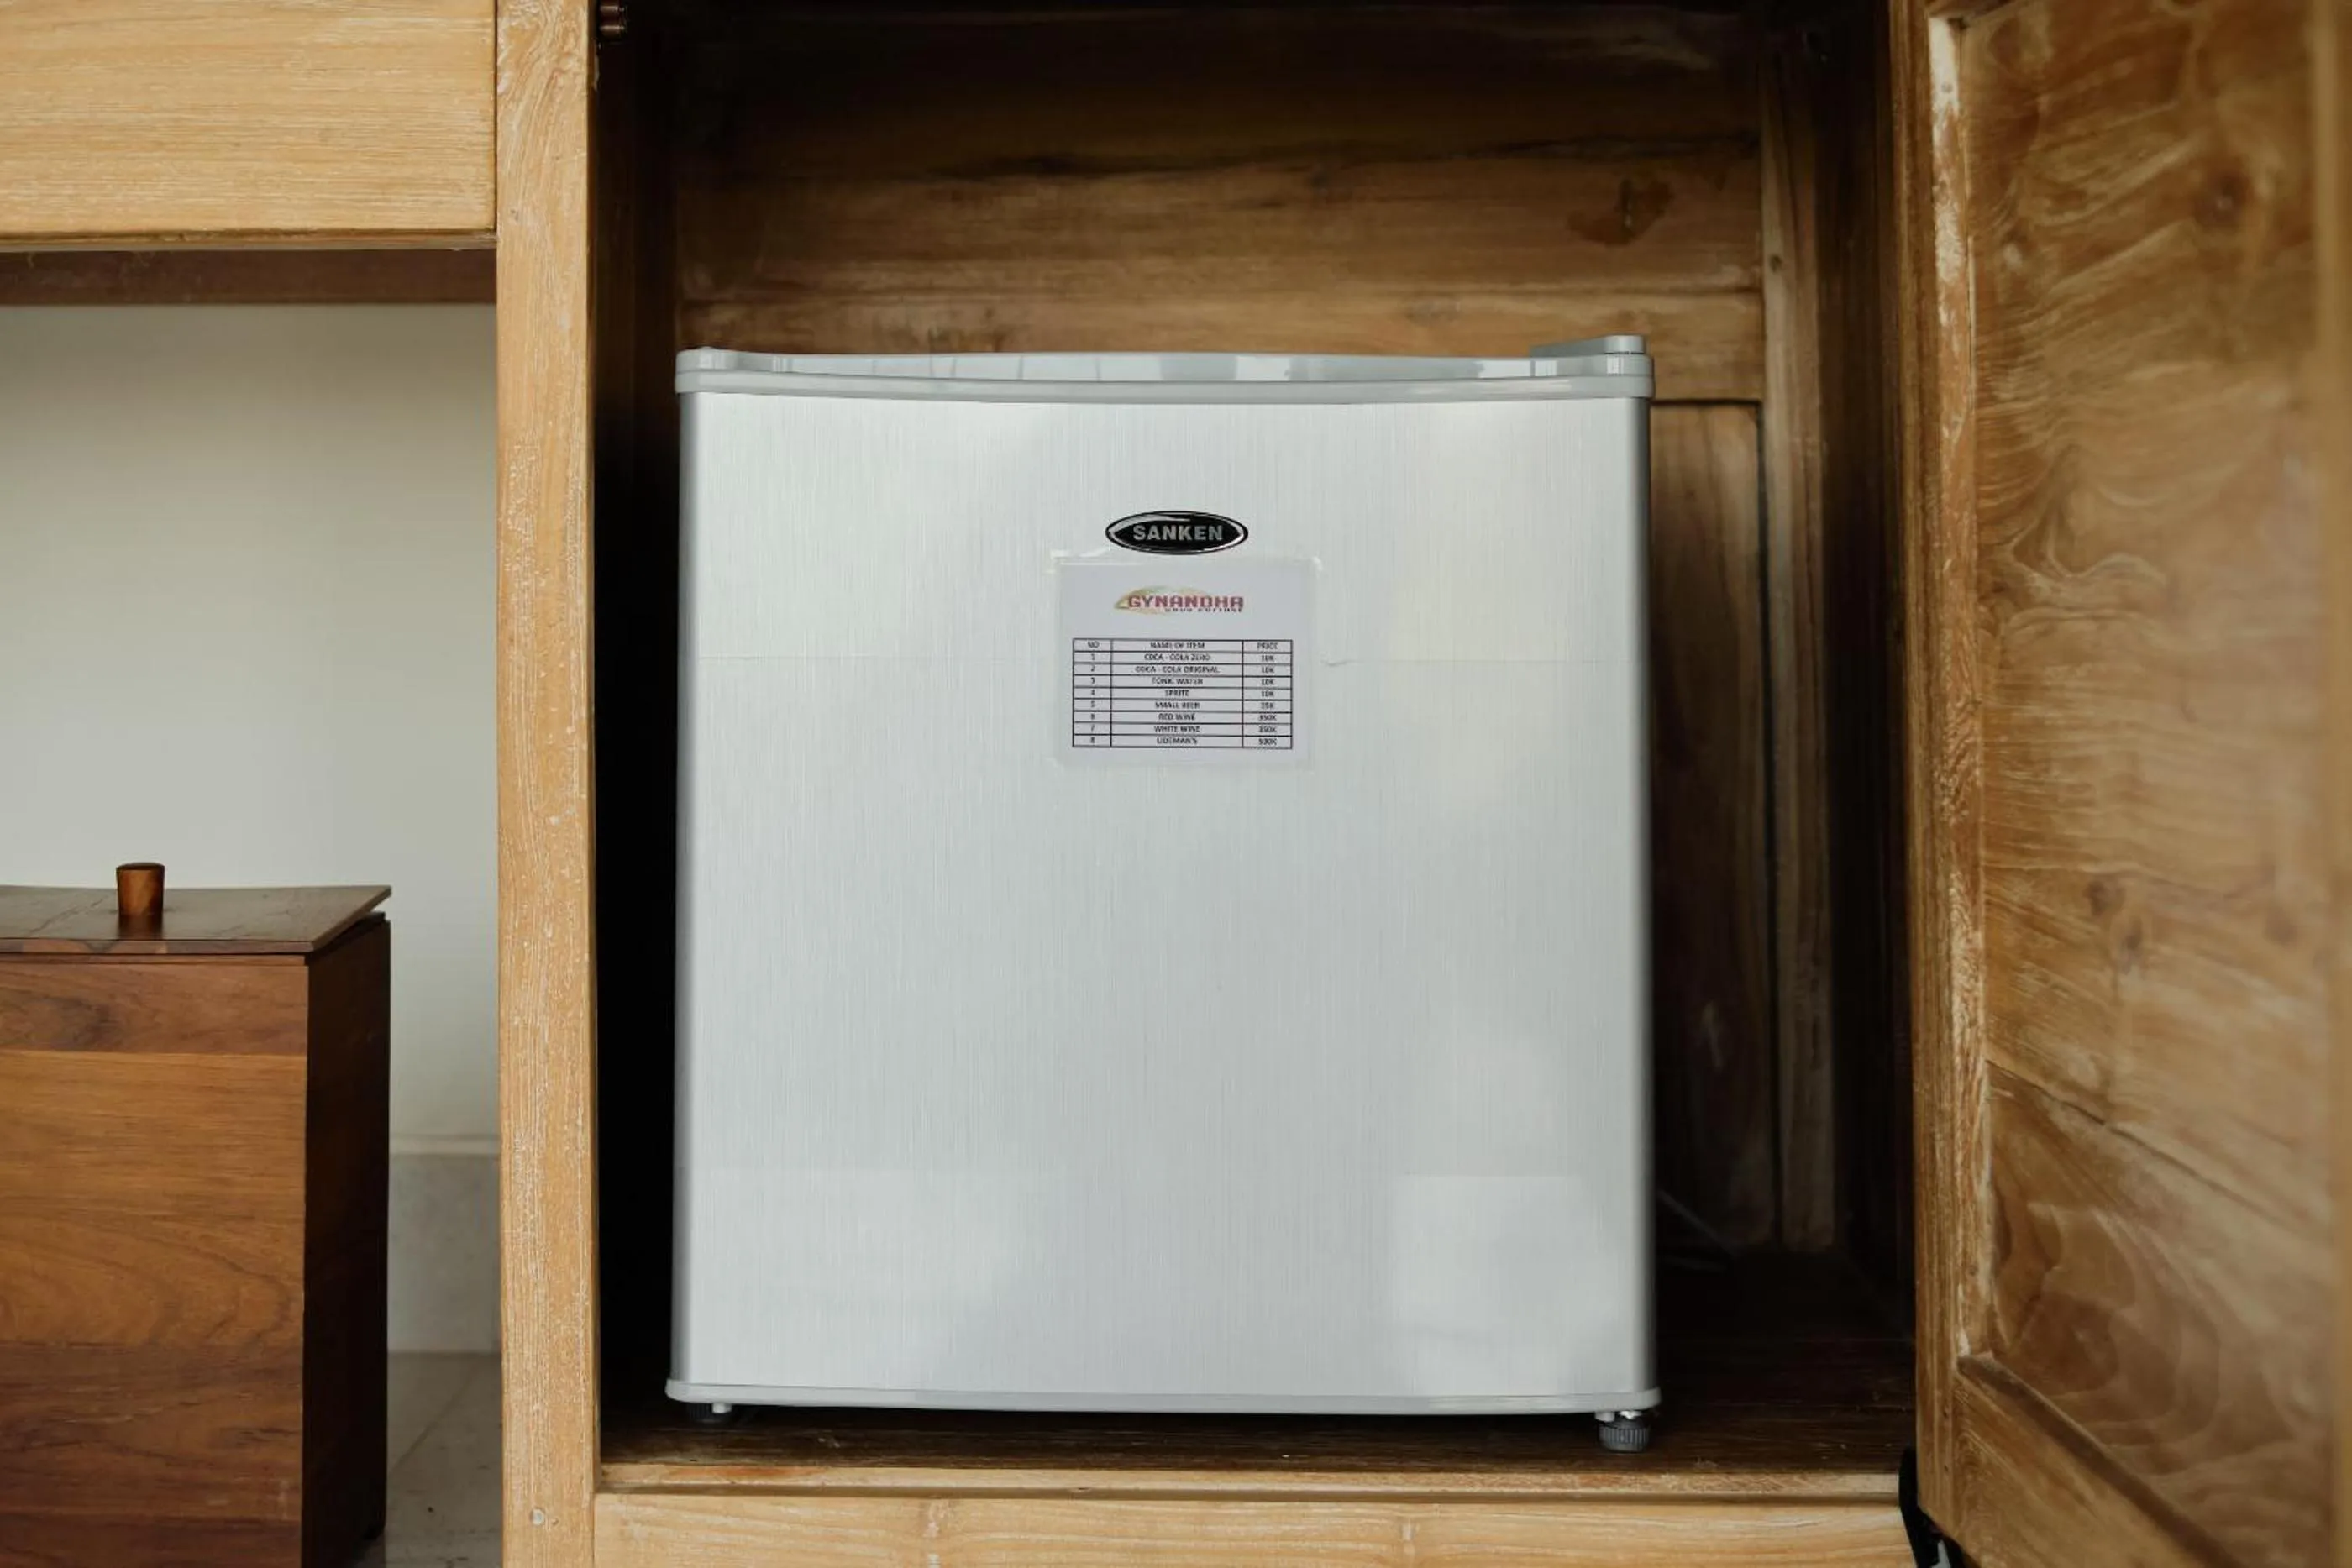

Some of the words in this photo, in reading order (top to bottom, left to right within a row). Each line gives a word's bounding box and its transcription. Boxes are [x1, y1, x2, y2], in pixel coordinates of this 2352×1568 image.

[1133, 524, 1223, 541] SANKEN
[1169, 653, 1189, 662] COLA
[1191, 653, 1211, 662] ZERO
[1181, 701, 1200, 710] BEER
[1175, 713, 1195, 721] WINE
